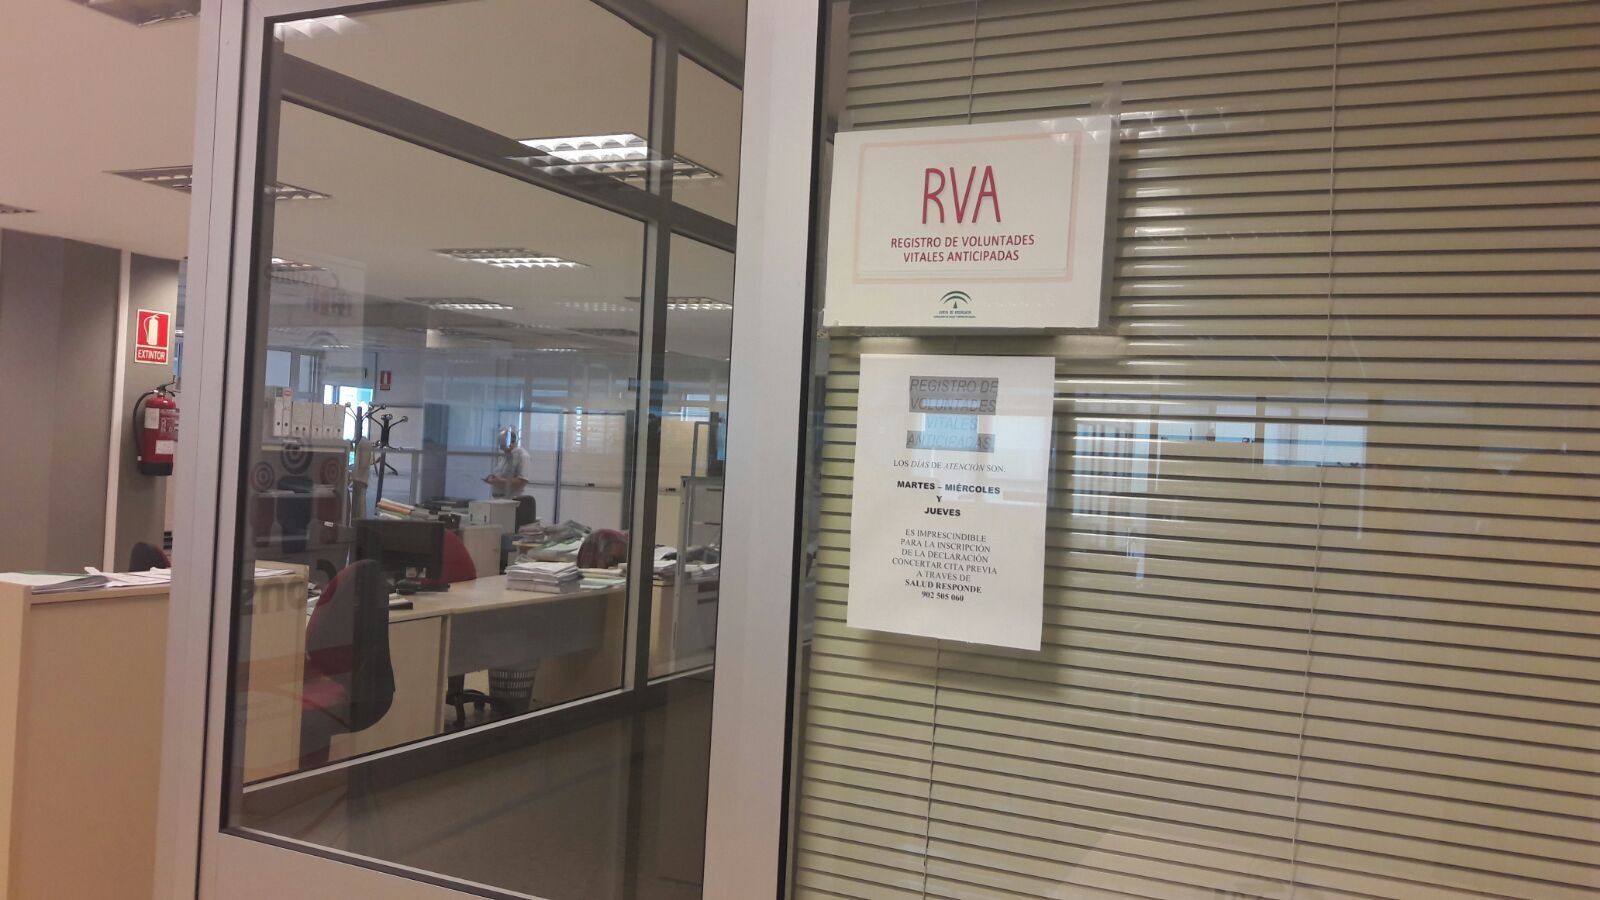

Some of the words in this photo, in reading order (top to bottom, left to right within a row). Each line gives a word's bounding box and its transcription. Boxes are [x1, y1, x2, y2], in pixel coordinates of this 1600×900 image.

[922, 165, 1001, 224] RVA
[891, 237, 941, 249] REGISTRO
[945, 236, 958, 248] DE
[962, 234, 1035, 247] VOLUNTADES
[903, 252, 944, 263] VITALES
[947, 250, 1019, 262] ANTICIPADAS
[138, 350, 165, 361] EXTINTOR
[910, 379, 977, 393] REGISTRO
[980, 380, 998, 393] DE
[910, 397, 996, 412] VOLUNTADES
[926, 415, 978, 430] VITALES
[906, 433, 992, 449] ANTICIPADAS
[893, 459, 909, 467] LOS
[911, 458, 929, 469] DÍAS
[931, 461, 941, 469] DE
[943, 461, 985, 472] ATENCIÓN
[897, 480, 935, 490] MARTES
[945, 483, 1001, 495] MIÉRCOLES
[936, 495, 943, 503] Y
[924, 507, 961, 517] JUEVES
[905, 528, 915, 537] ES
[917, 530, 987, 542] IMPRESCINDIBLE
[900, 538, 922, 548] PARA
[924, 540, 935, 548] LA
[901, 548, 912, 557] DE
[914, 549, 925, 558] LA
[892, 557, 942, 570] CONCERTAR
[943, 562, 964, 572] CITA
[966, 564, 998, 575] PREVIA
[916, 570, 923, 578] A
[959, 573, 971, 583] DE
[905, 579, 934, 589] SALUD
[935, 581, 982, 593] RESPONDE
[921, 590, 935, 600] 902
[936, 592, 949, 601] 505
[950, 593, 964, 602] 060
